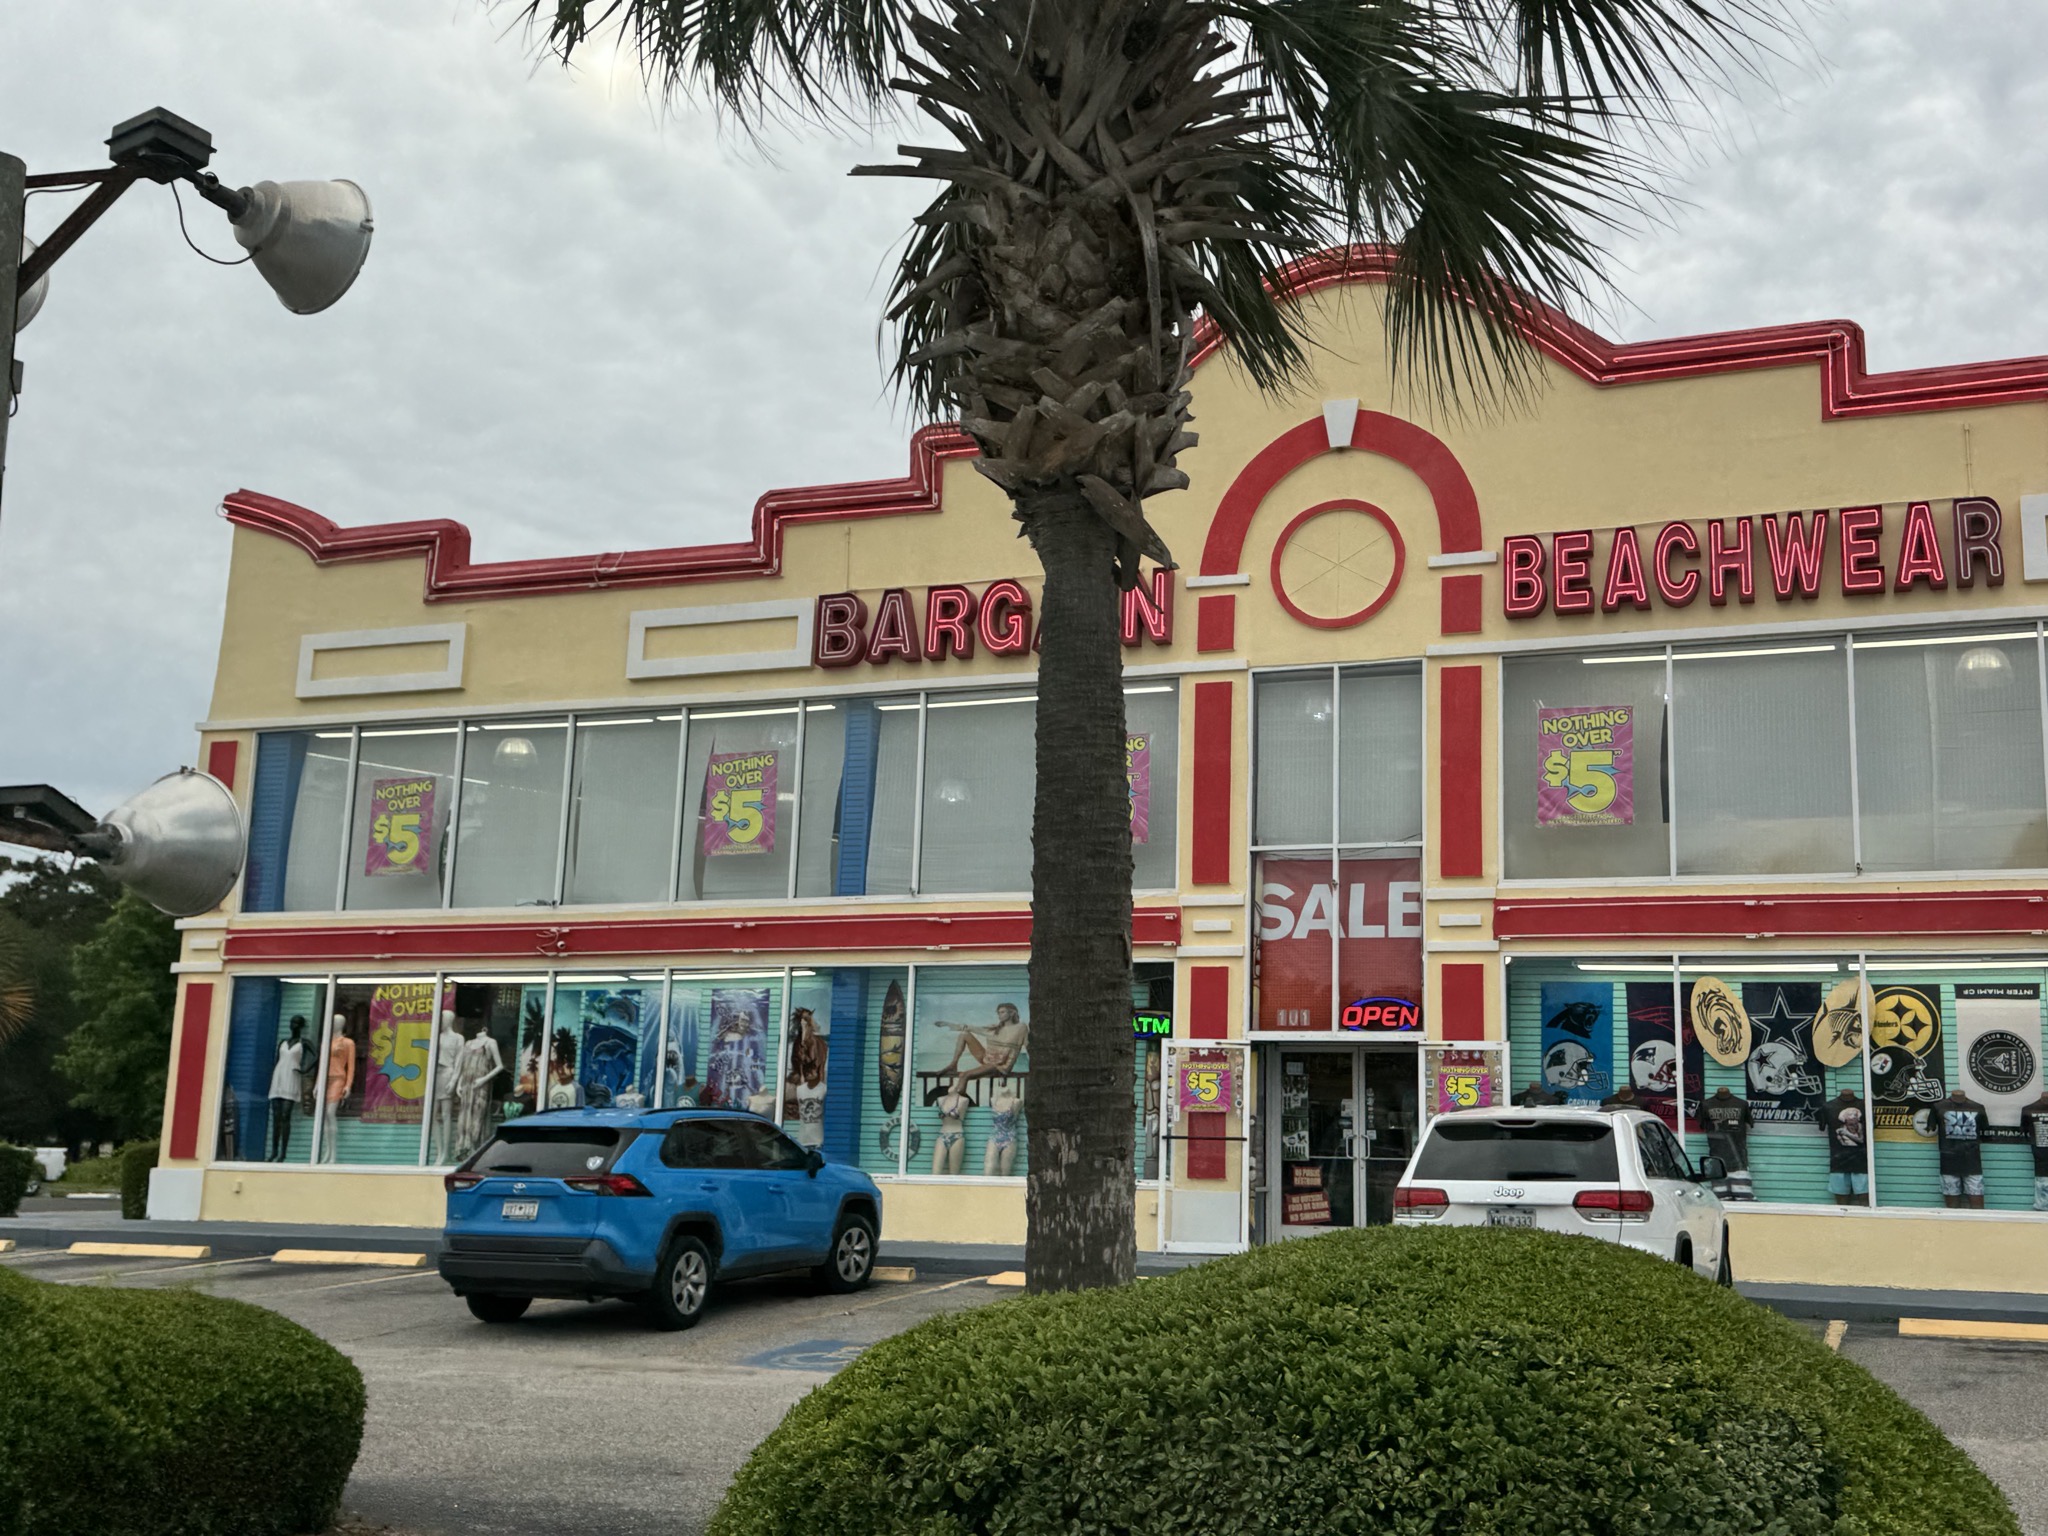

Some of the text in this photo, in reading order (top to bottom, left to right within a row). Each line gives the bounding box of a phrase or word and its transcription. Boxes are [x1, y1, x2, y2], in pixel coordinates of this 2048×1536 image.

[1503, 496, 2004, 619] BEACHWEAR
[815, 567, 1175, 668] BARGN
[1542, 709, 1629, 735] NOTHING
[1562, 728, 1614, 748] OVER
[711, 754, 775, 776] NOTHING
[725, 769, 763, 788] OVER
[376, 781, 432, 800] NOTHING
[388, 796, 421, 811] OVER
[373, 814, 420, 864] $5
[1261, 881, 1421, 941] SALE
[1342, 1006, 1420, 1027] OPEN
[1982, 1033, 2001, 1042] CLUB
[1440, 1066, 1470, 1074] NOTHING
[1188, 1071, 1220, 1102] $5
[1446, 1075, 1478, 1106] $5
[1751, 1108, 1801, 1120] COWBOYS
[1944, 1110, 1979, 1126] SIX
[1494, 1186, 1525, 1199] Jeep
